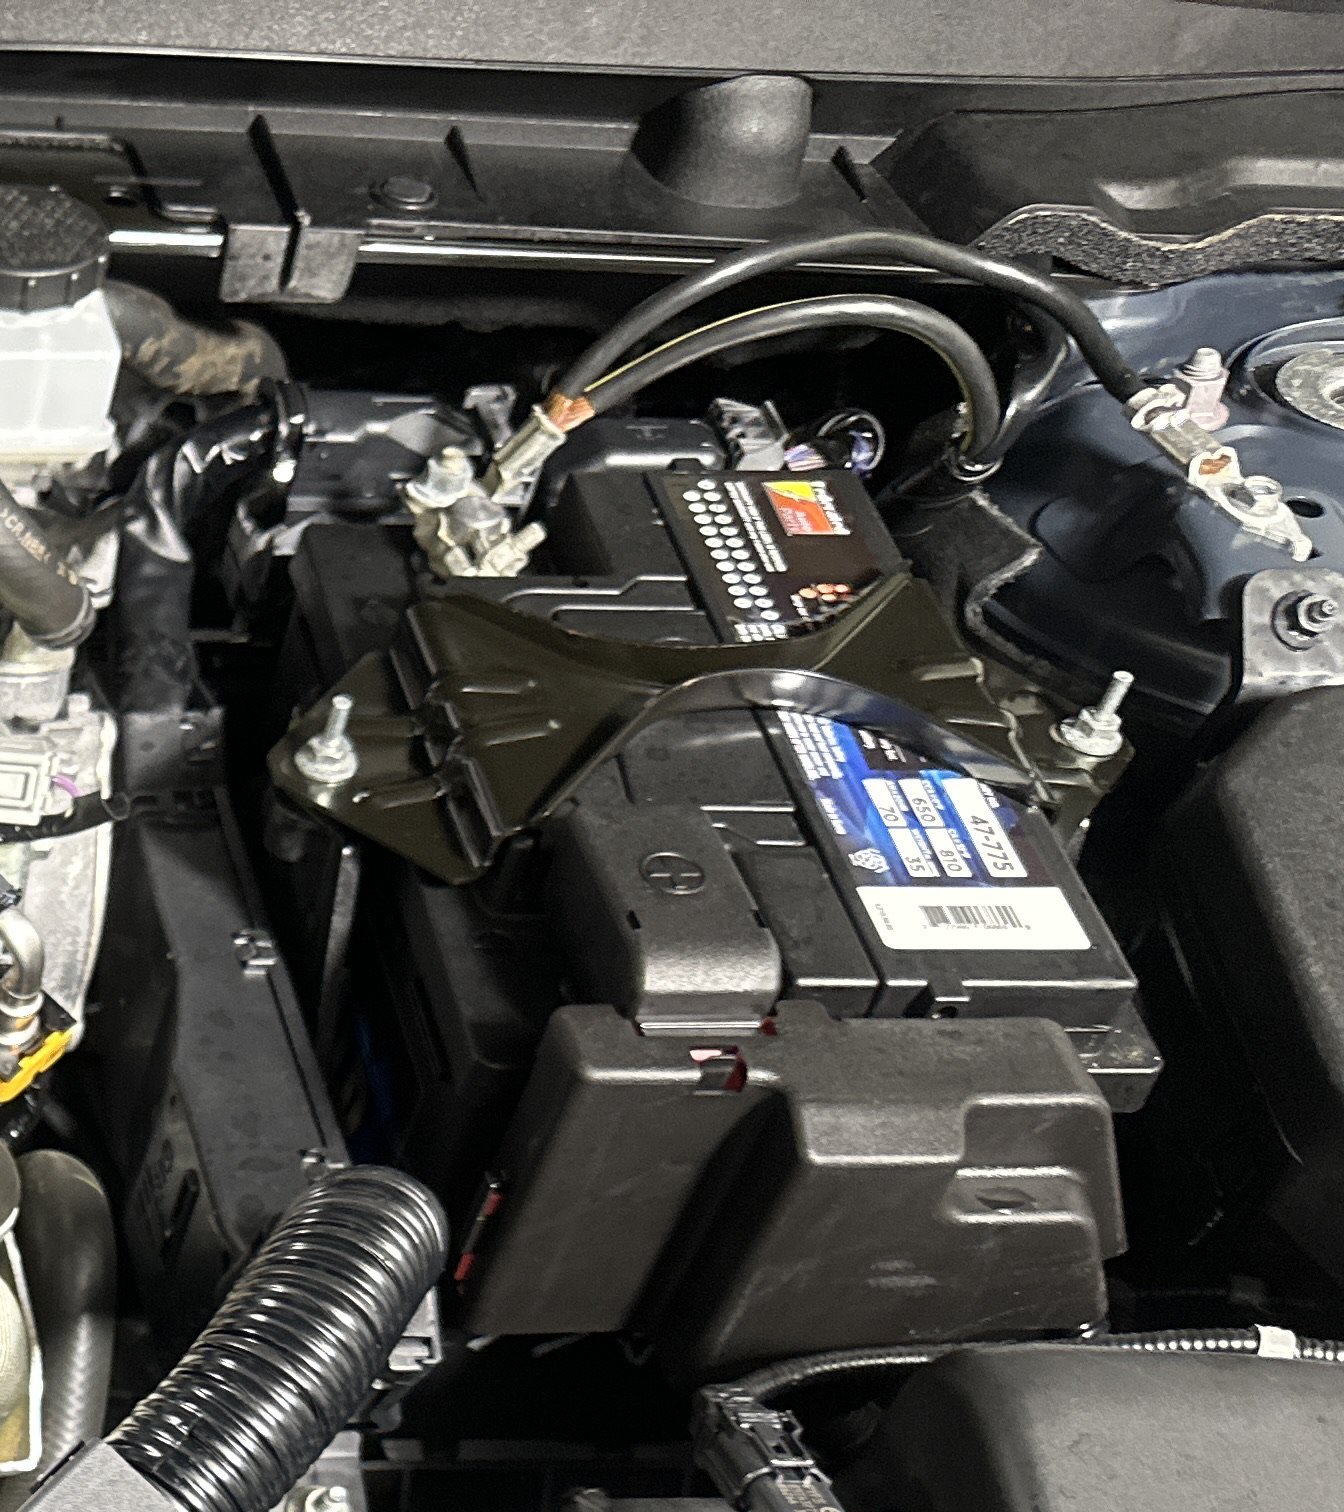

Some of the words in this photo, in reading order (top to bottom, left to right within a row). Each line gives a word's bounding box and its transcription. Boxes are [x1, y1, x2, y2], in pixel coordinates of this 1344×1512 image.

[879, 805, 899, 822] 70
[911, 797, 936, 823] 650
[969, 815, 1015, 871] 47-775
[905, 856, 925, 872] 35
[938, 850, 963, 872] 810
